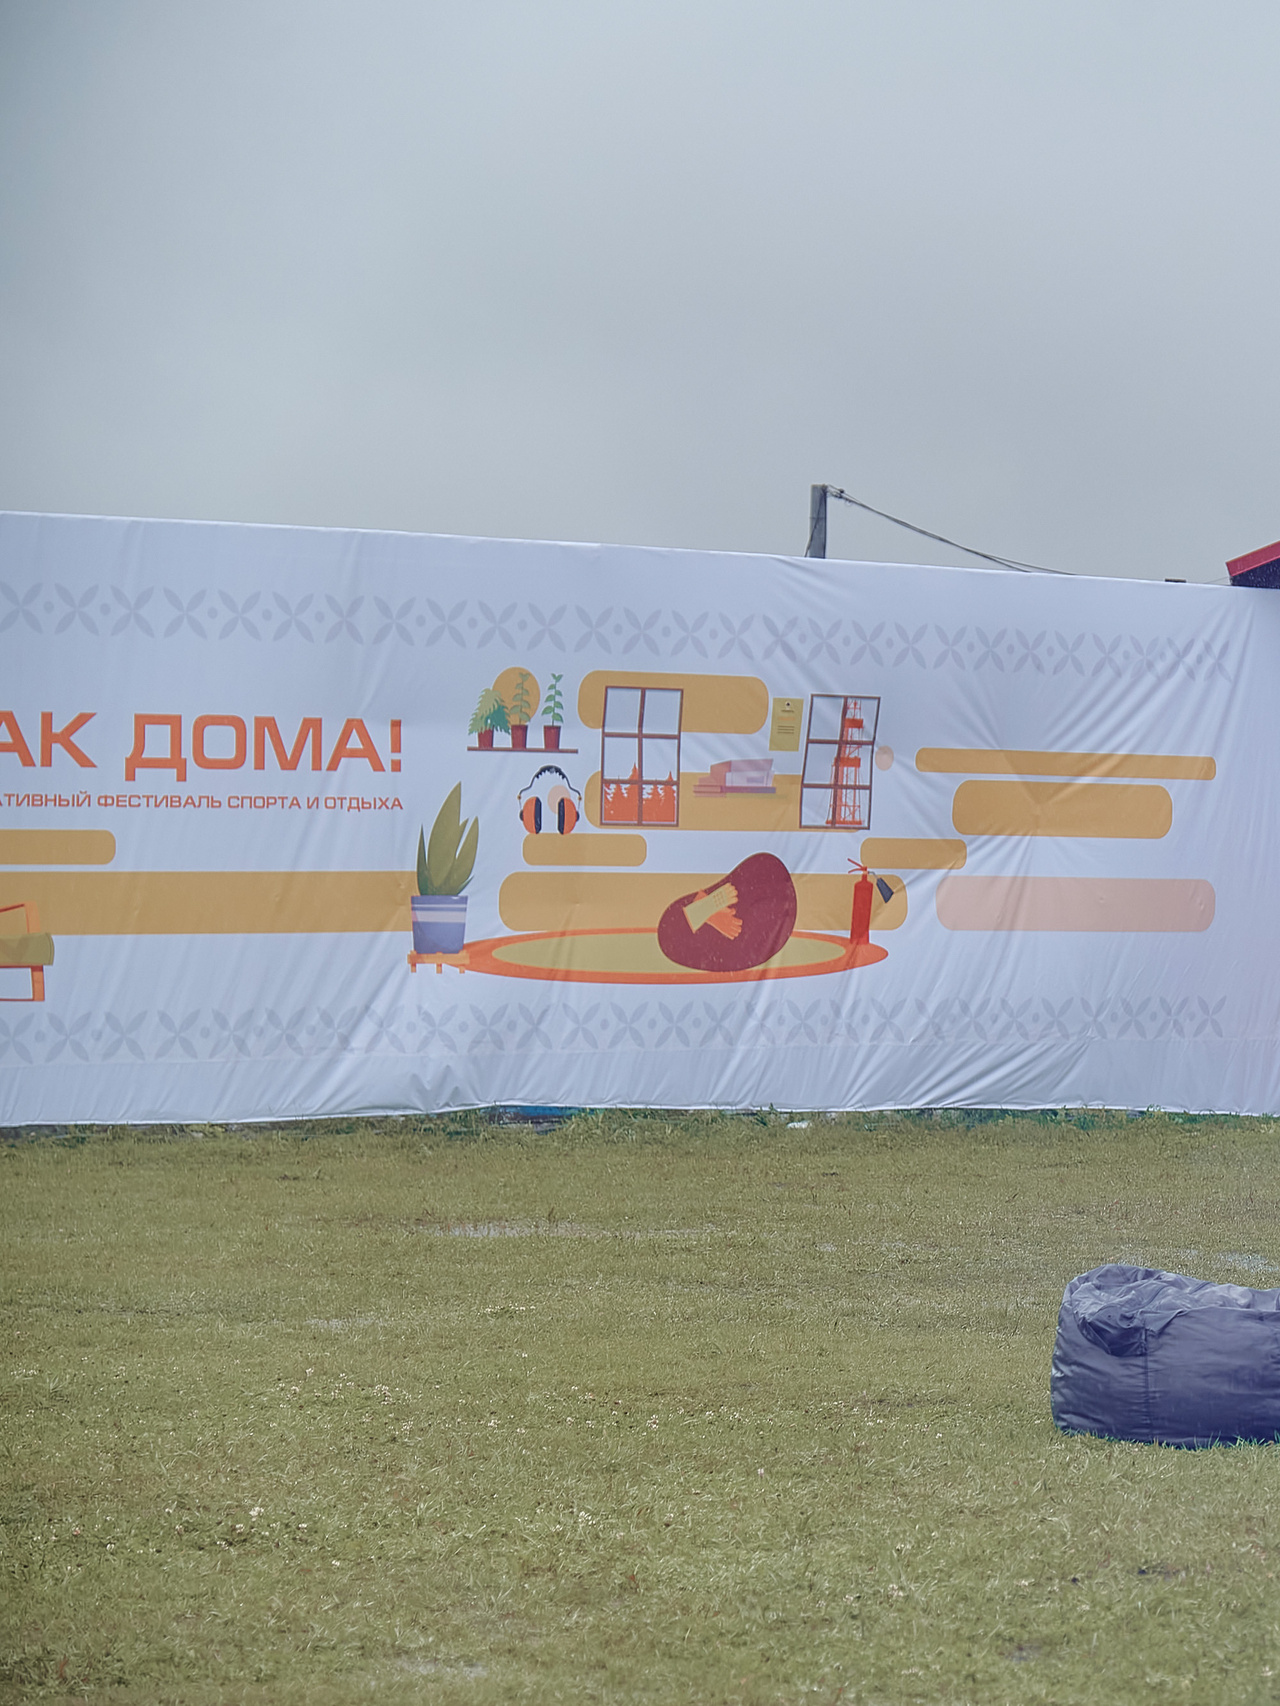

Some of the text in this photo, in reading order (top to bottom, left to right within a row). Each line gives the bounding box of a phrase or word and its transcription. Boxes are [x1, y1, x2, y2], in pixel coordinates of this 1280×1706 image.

[124, 713, 402, 782] ДОМА!
[0, 790, 404, 812] ТИВНЫЙ ФЕСТИВАЛЬ СПОРТА И ОТДЫХА
